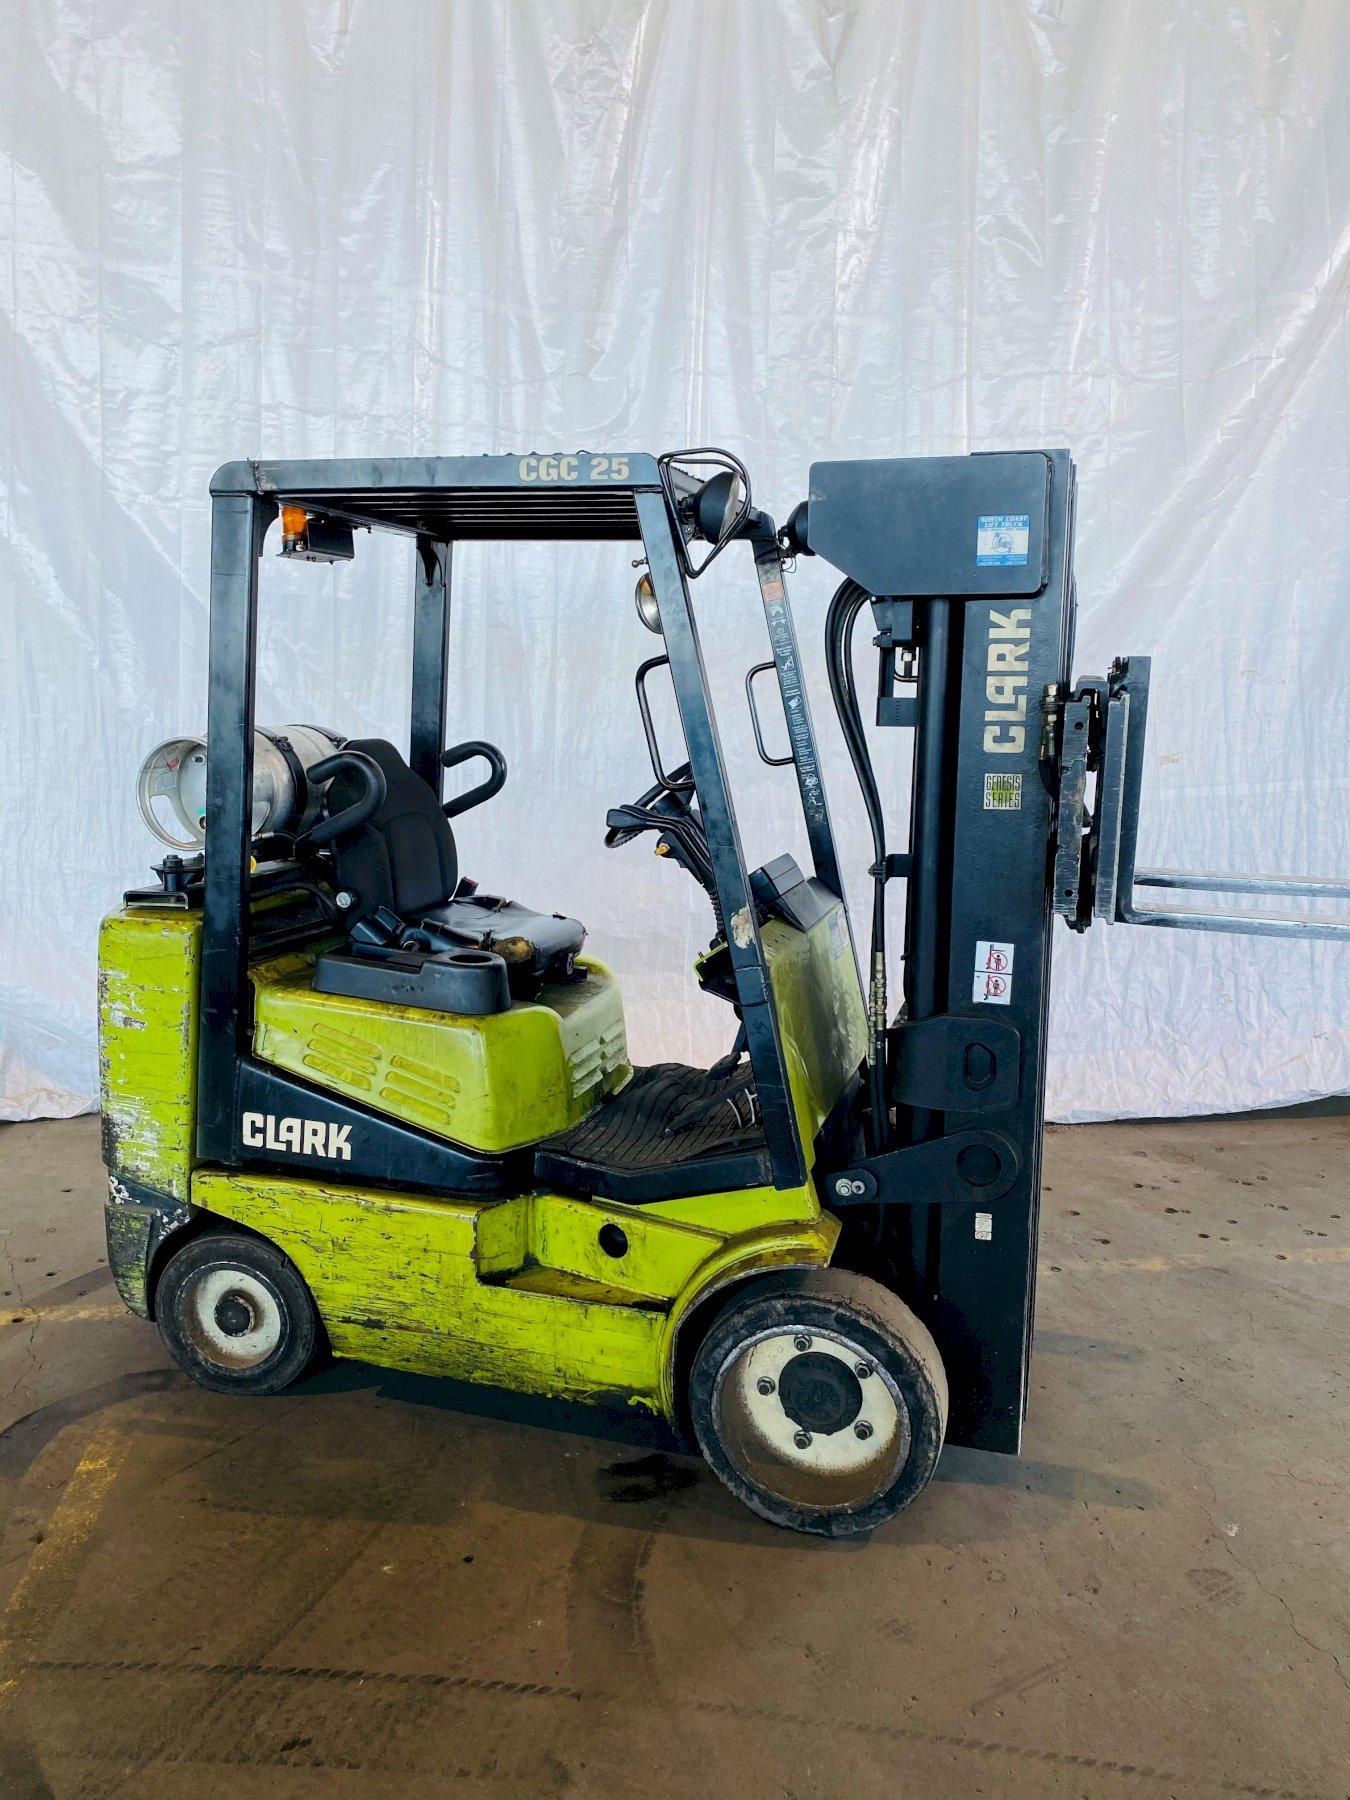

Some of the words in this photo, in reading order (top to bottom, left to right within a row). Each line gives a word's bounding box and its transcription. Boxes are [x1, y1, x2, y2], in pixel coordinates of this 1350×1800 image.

[519, 456, 579, 482] CGC
[589, 456, 630, 481] 25
[983, 608, 1032, 754] CLARK
[986, 775, 1021, 791] GENESIS
[985, 792, 1020, 808] SERIES
[242, 1111, 353, 1161] CLARK
